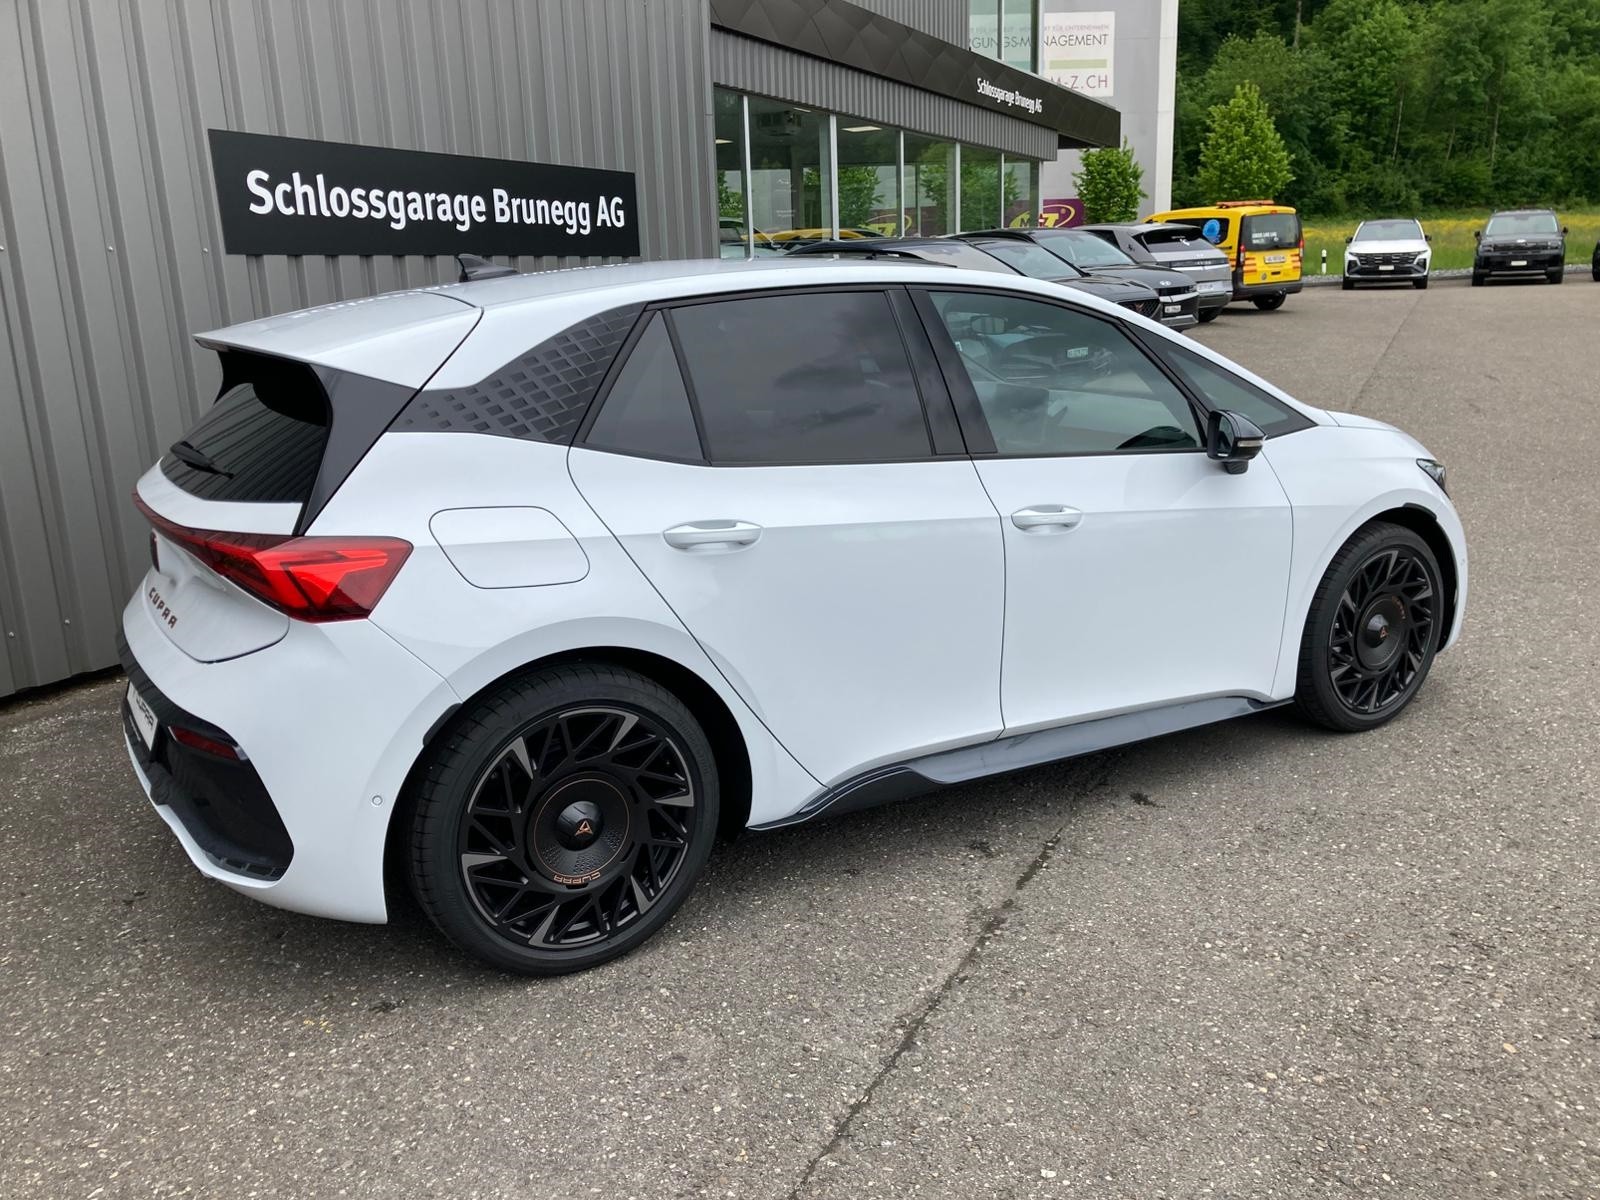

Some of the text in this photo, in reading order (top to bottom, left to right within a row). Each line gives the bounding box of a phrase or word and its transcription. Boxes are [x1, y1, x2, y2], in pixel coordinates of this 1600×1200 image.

[977, 77, 1042, 114] Schlossgarage Brunegg AG
[246, 169, 625, 235] Schlossgarage Brunegg AG
[148, 586, 178, 629] CUPRA
[553, 871, 601, 884] CUPRA
